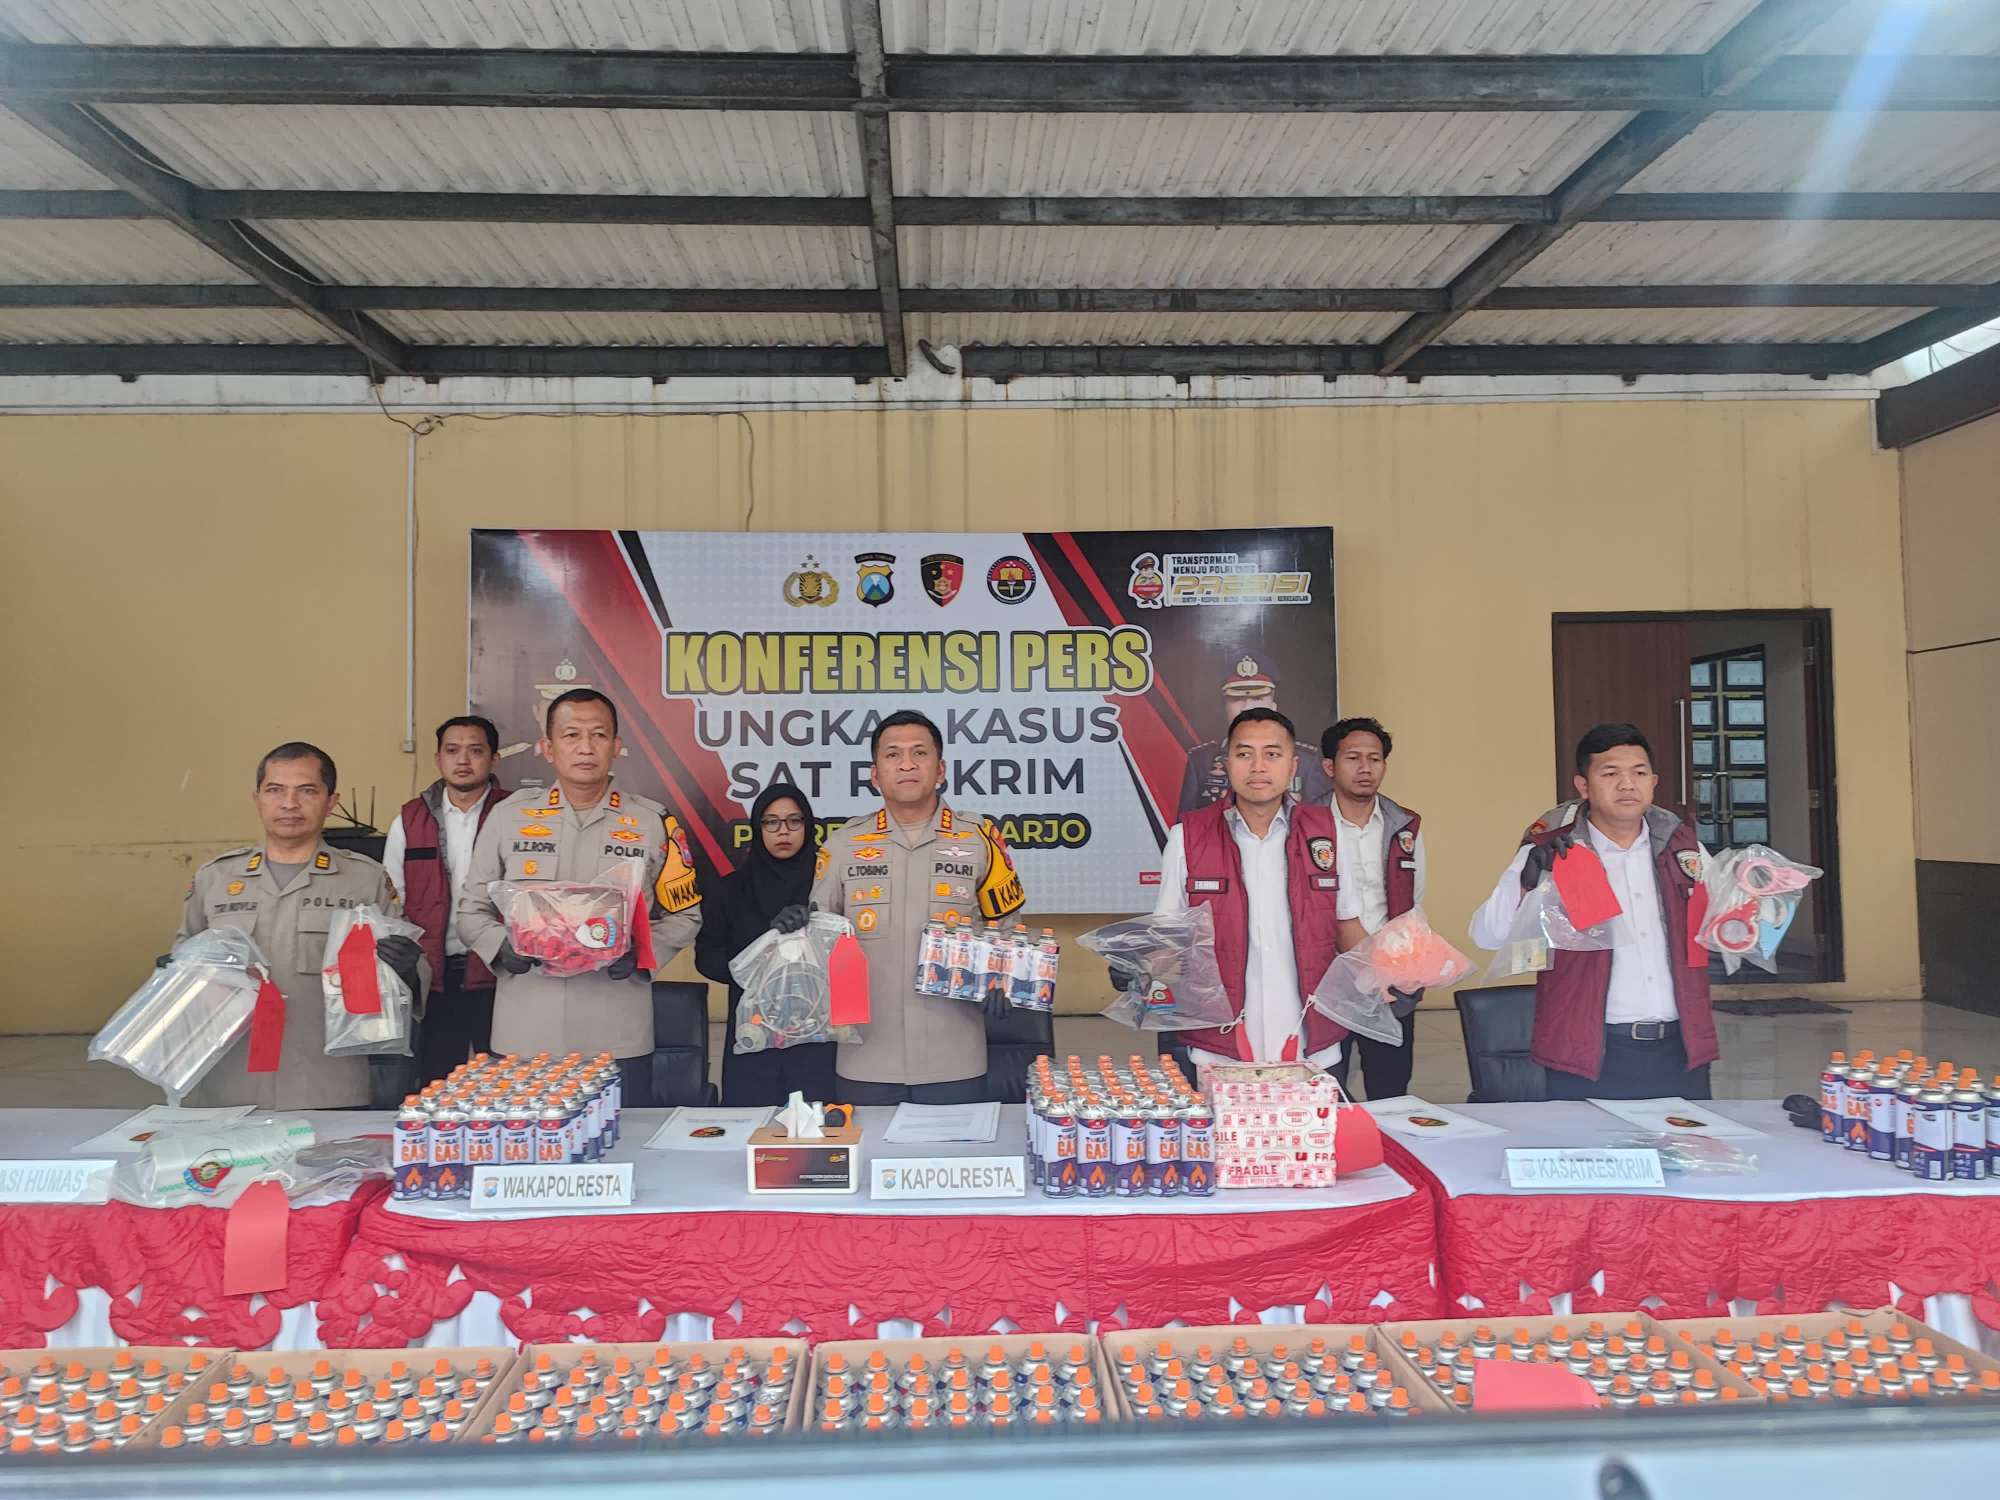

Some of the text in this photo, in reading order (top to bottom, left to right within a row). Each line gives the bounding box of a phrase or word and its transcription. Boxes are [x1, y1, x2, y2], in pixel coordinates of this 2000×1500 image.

[1171, 555, 1236, 564] TRANSFORMASI
[1173, 565, 1207, 574] MENUJU
[1209, 565, 1233, 574] POLRI
[667, 630, 1152, 694] KONFERENSI PERS
[700, 707, 1119, 747] UNGKA KASUS
[731, 758, 1085, 799] SAT RKRIM
[604, 844, 645, 858] POLRI
[934, 862, 973, 877] POLRI
[302, 897, 354, 909] POLRI
[1214, 1131, 1238, 1141] GILE
[538, 1143, 563, 1161] GAS
[1186, 1141, 1210, 1158] GAS
[1229, 1164, 1278, 1175] FRAGILE
[1537, 1157, 1655, 1179] KASATRESKRIM
[24, 1167, 84, 1192] HUMAS
[503, 1174, 622, 1198] WAKAPOLRESTA
[901, 1166, 1016, 1190] KAPOLRESTA
